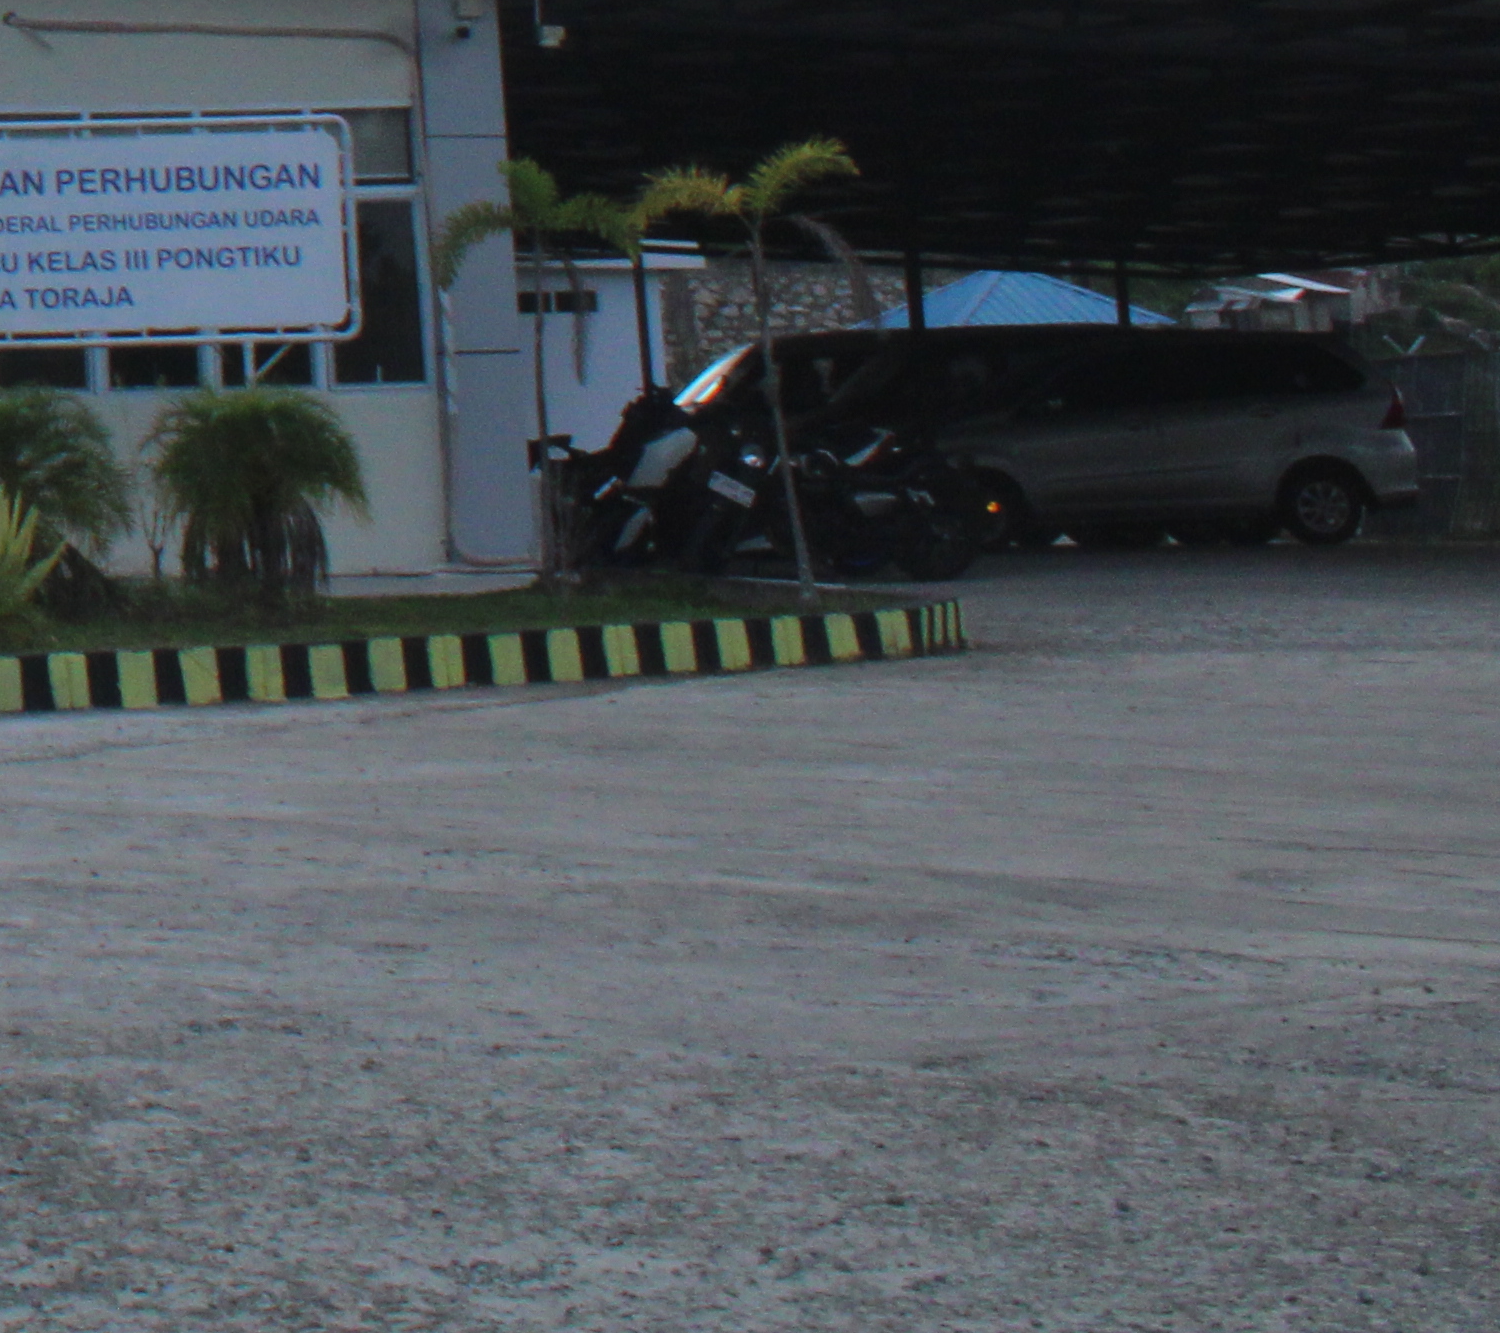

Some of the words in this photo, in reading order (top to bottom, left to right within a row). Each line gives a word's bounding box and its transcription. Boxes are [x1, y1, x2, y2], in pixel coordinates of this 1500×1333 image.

[55, 163, 320, 194] PERHUBUNGAN
[69, 212, 237, 232] PERHUBUNGAN
[244, 209, 320, 228] UDARA
[28, 250, 116, 272] KELAS
[125, 249, 147, 269] III
[157, 246, 299, 268] PONGTIKU
[25, 287, 133, 308] TORAJA
